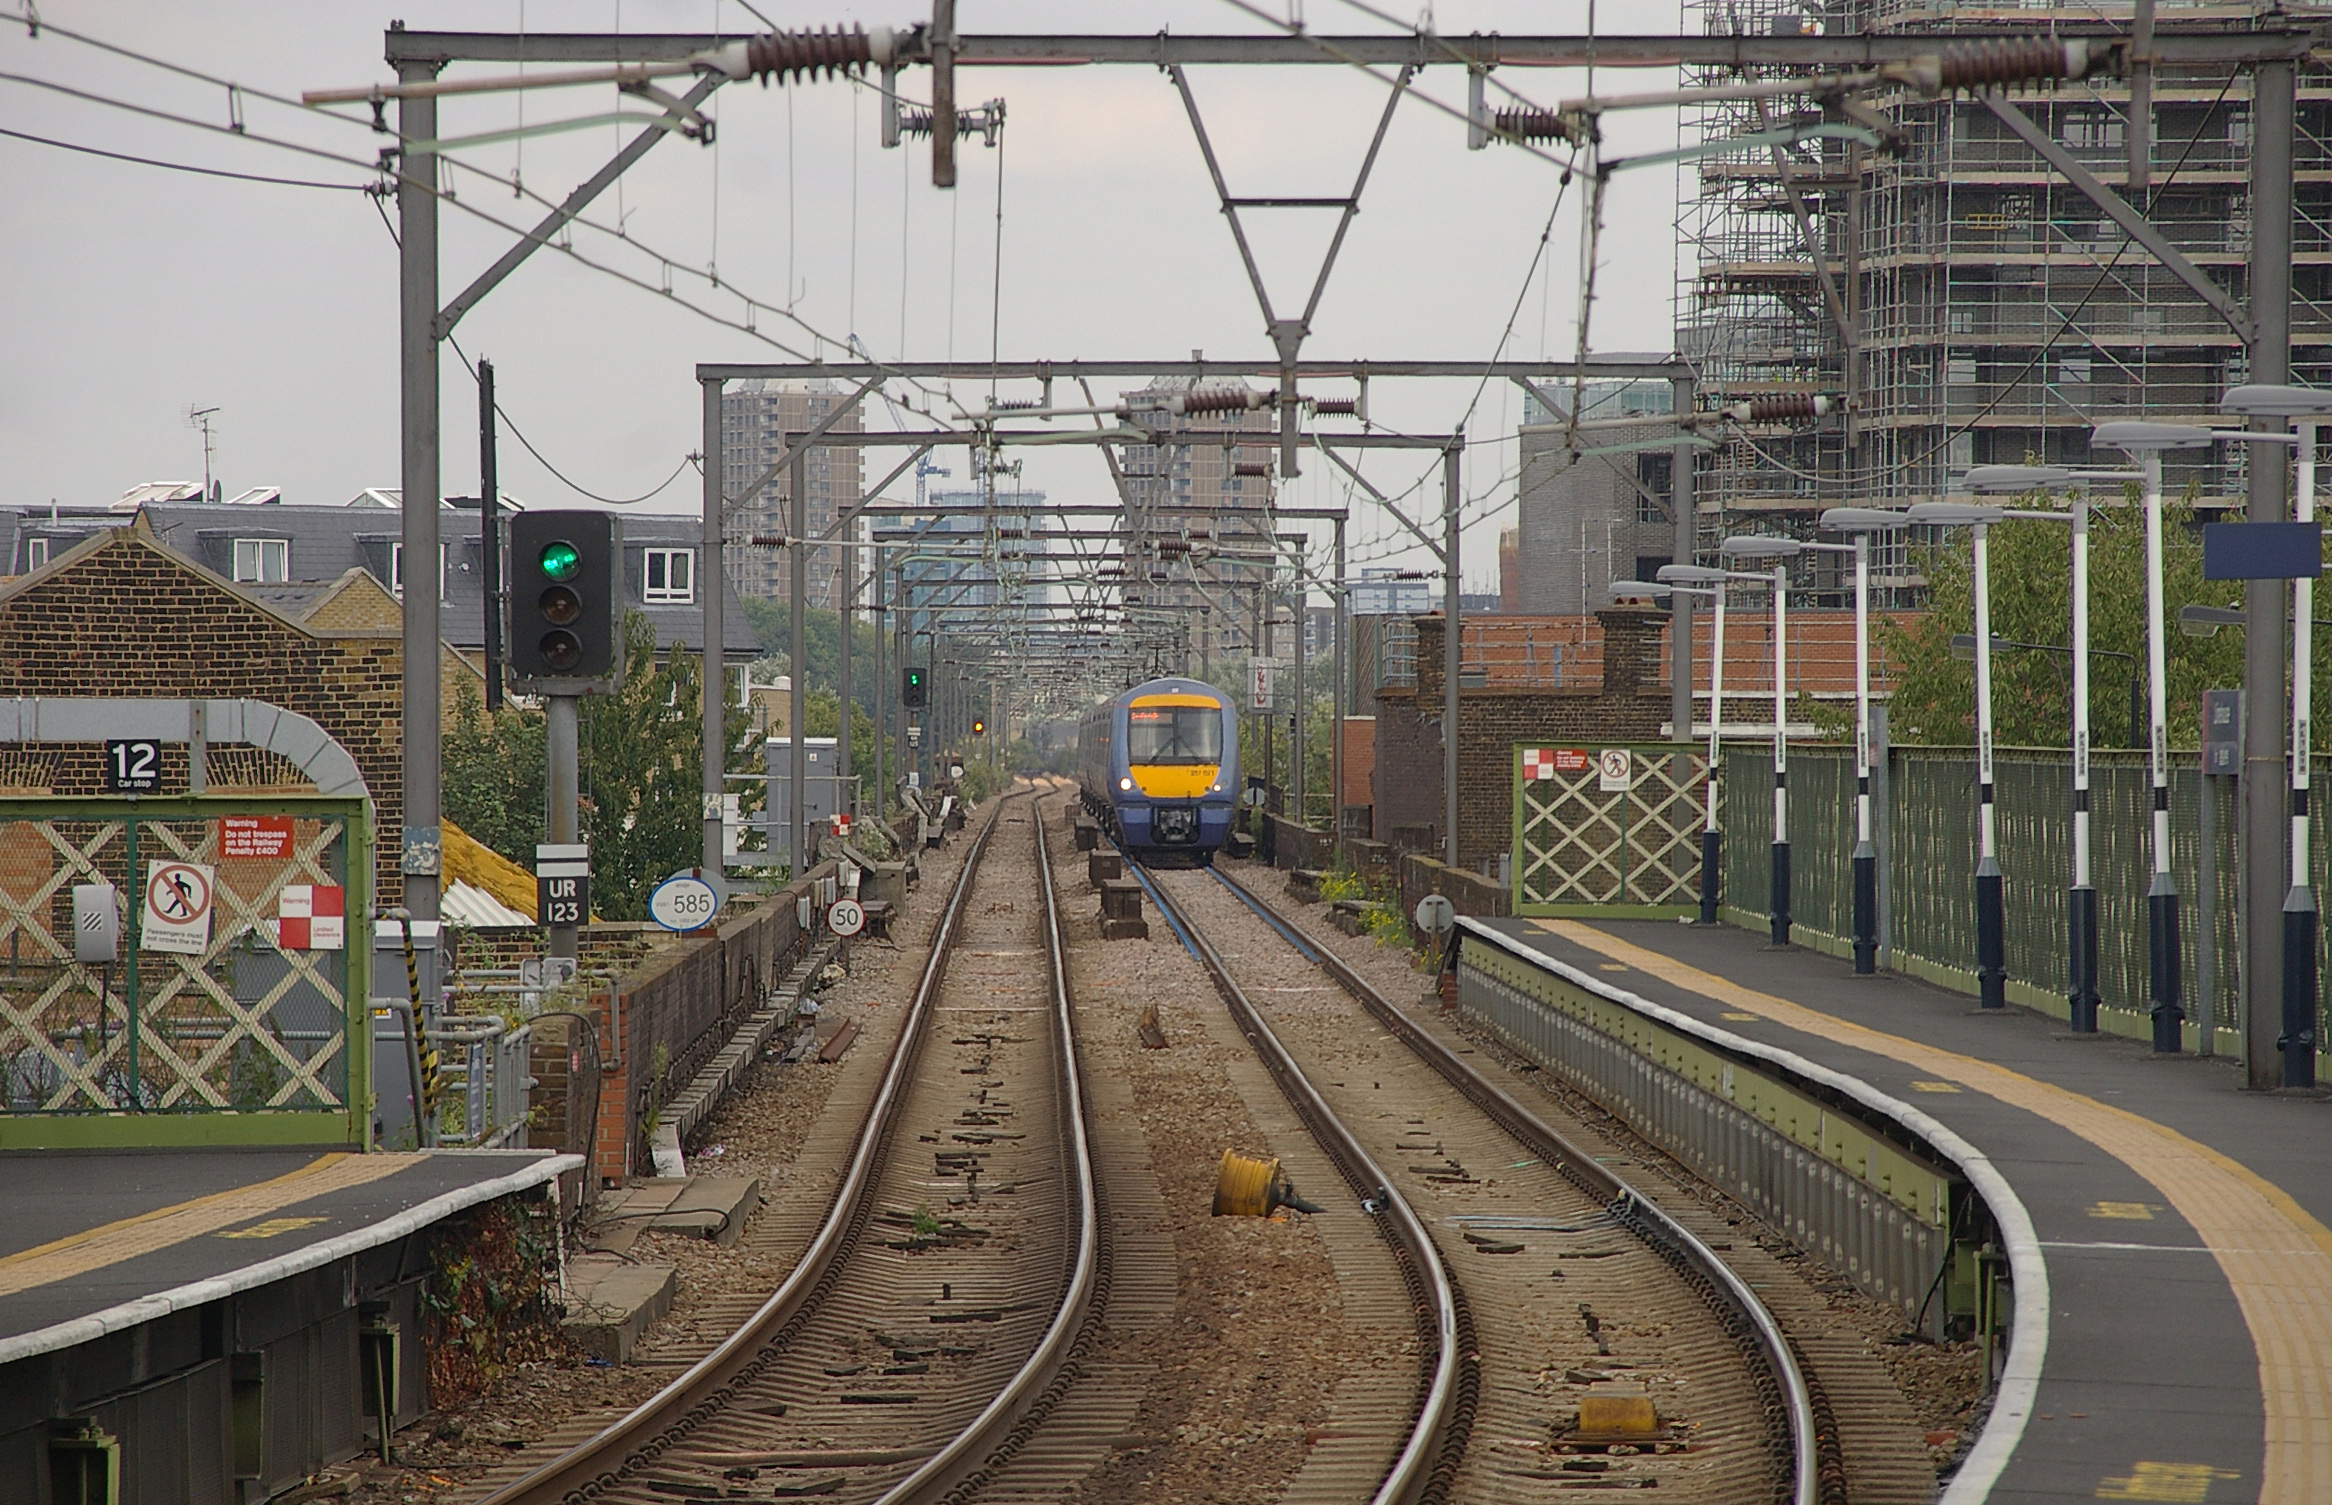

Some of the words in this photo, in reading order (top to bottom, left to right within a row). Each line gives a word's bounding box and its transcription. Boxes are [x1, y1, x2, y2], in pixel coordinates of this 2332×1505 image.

[112, 743, 156, 778] 12
[117, 779, 132, 788] Car
[133, 779, 152, 789] stop
[225, 820, 258, 829] Warning
[225, 830, 237, 838] Do
[237, 830, 252, 838] not
[253, 830, 287, 839] trespass
[237, 839, 251, 847] the
[252, 839, 283, 848] Railway
[225, 847, 255, 856] Penalty
[549, 879, 576, 898] UR
[282, 897, 310, 906] Warning
[674, 894, 710, 914] 585
[548, 902, 579, 922] 123
[835, 908, 859, 926] 50
[146, 928, 185, 938] Passengers
[187, 932, 203, 940] must
[159, 936, 177, 944] cross
